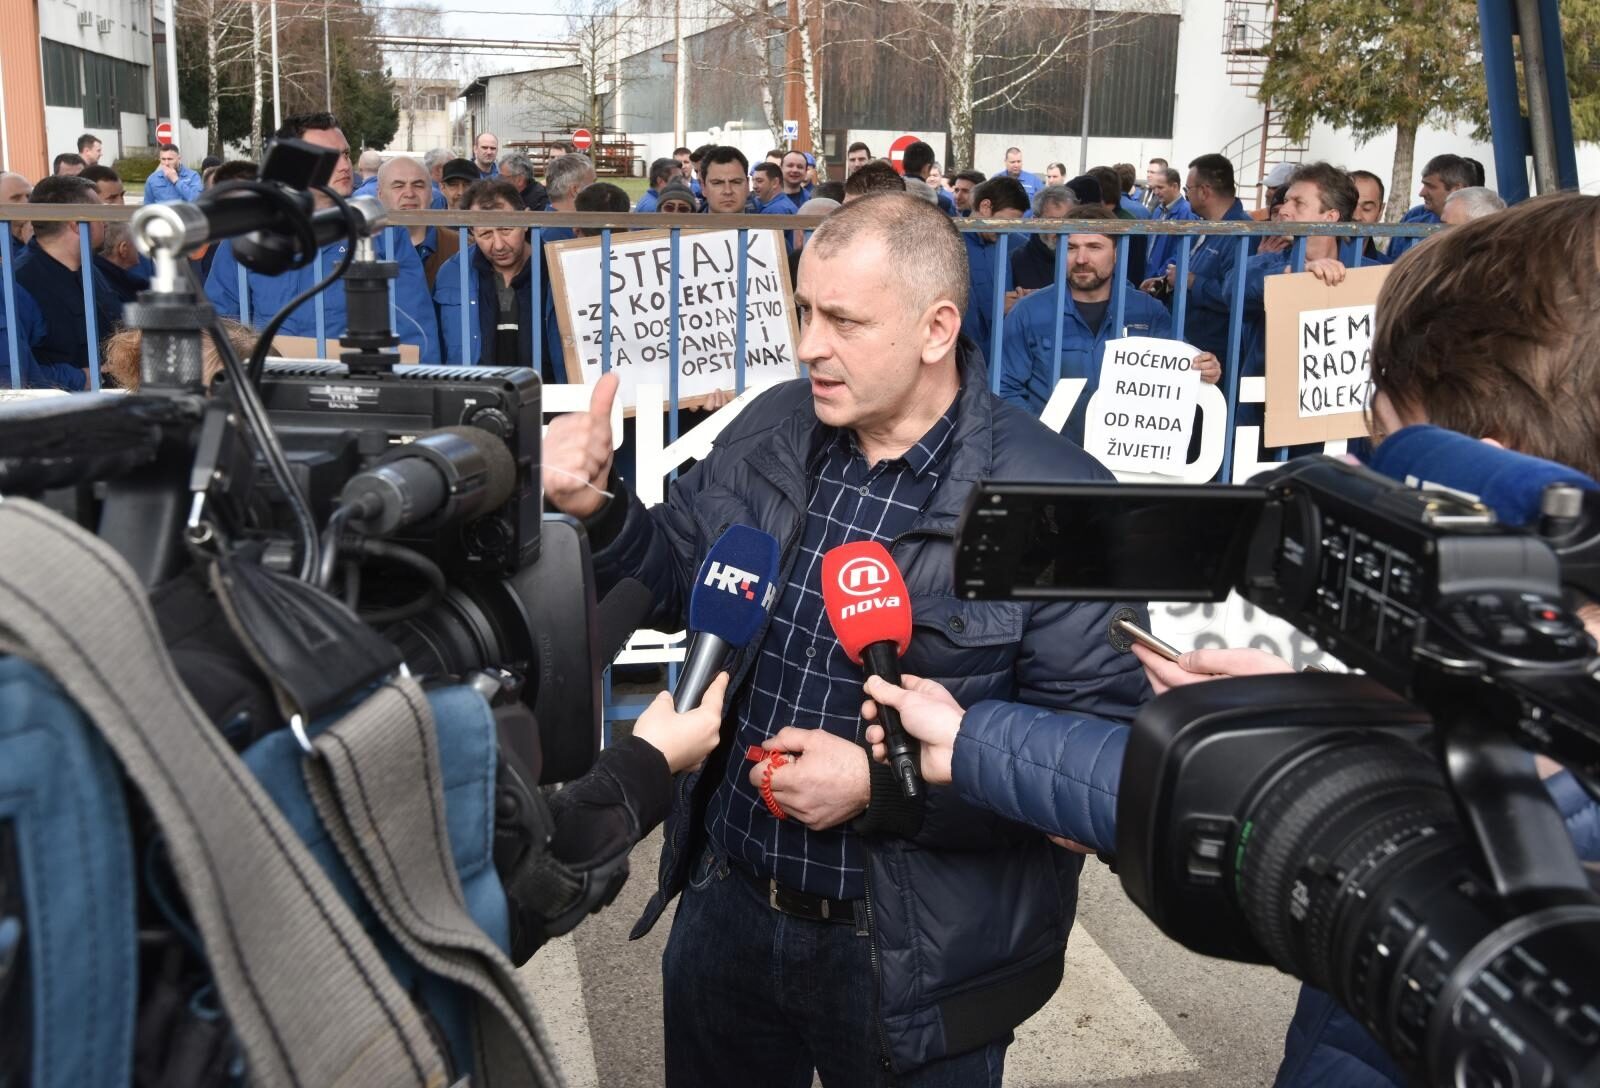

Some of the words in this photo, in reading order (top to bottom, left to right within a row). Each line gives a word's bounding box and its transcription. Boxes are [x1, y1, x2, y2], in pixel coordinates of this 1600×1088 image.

[587, 348, 632, 368] -A
[1114, 350, 1191, 372] HOĆEMO
[1116, 380, 1171, 399] RADITI
[1176, 386, 1181, 400] I
[1104, 412, 1129, 427] OD
[1135, 414, 1182, 432] RADA
[1107, 438, 1172, 460] ŽIVJETI!
[703, 561, 760, 600] HRT
[841, 595, 901, 619] nova
